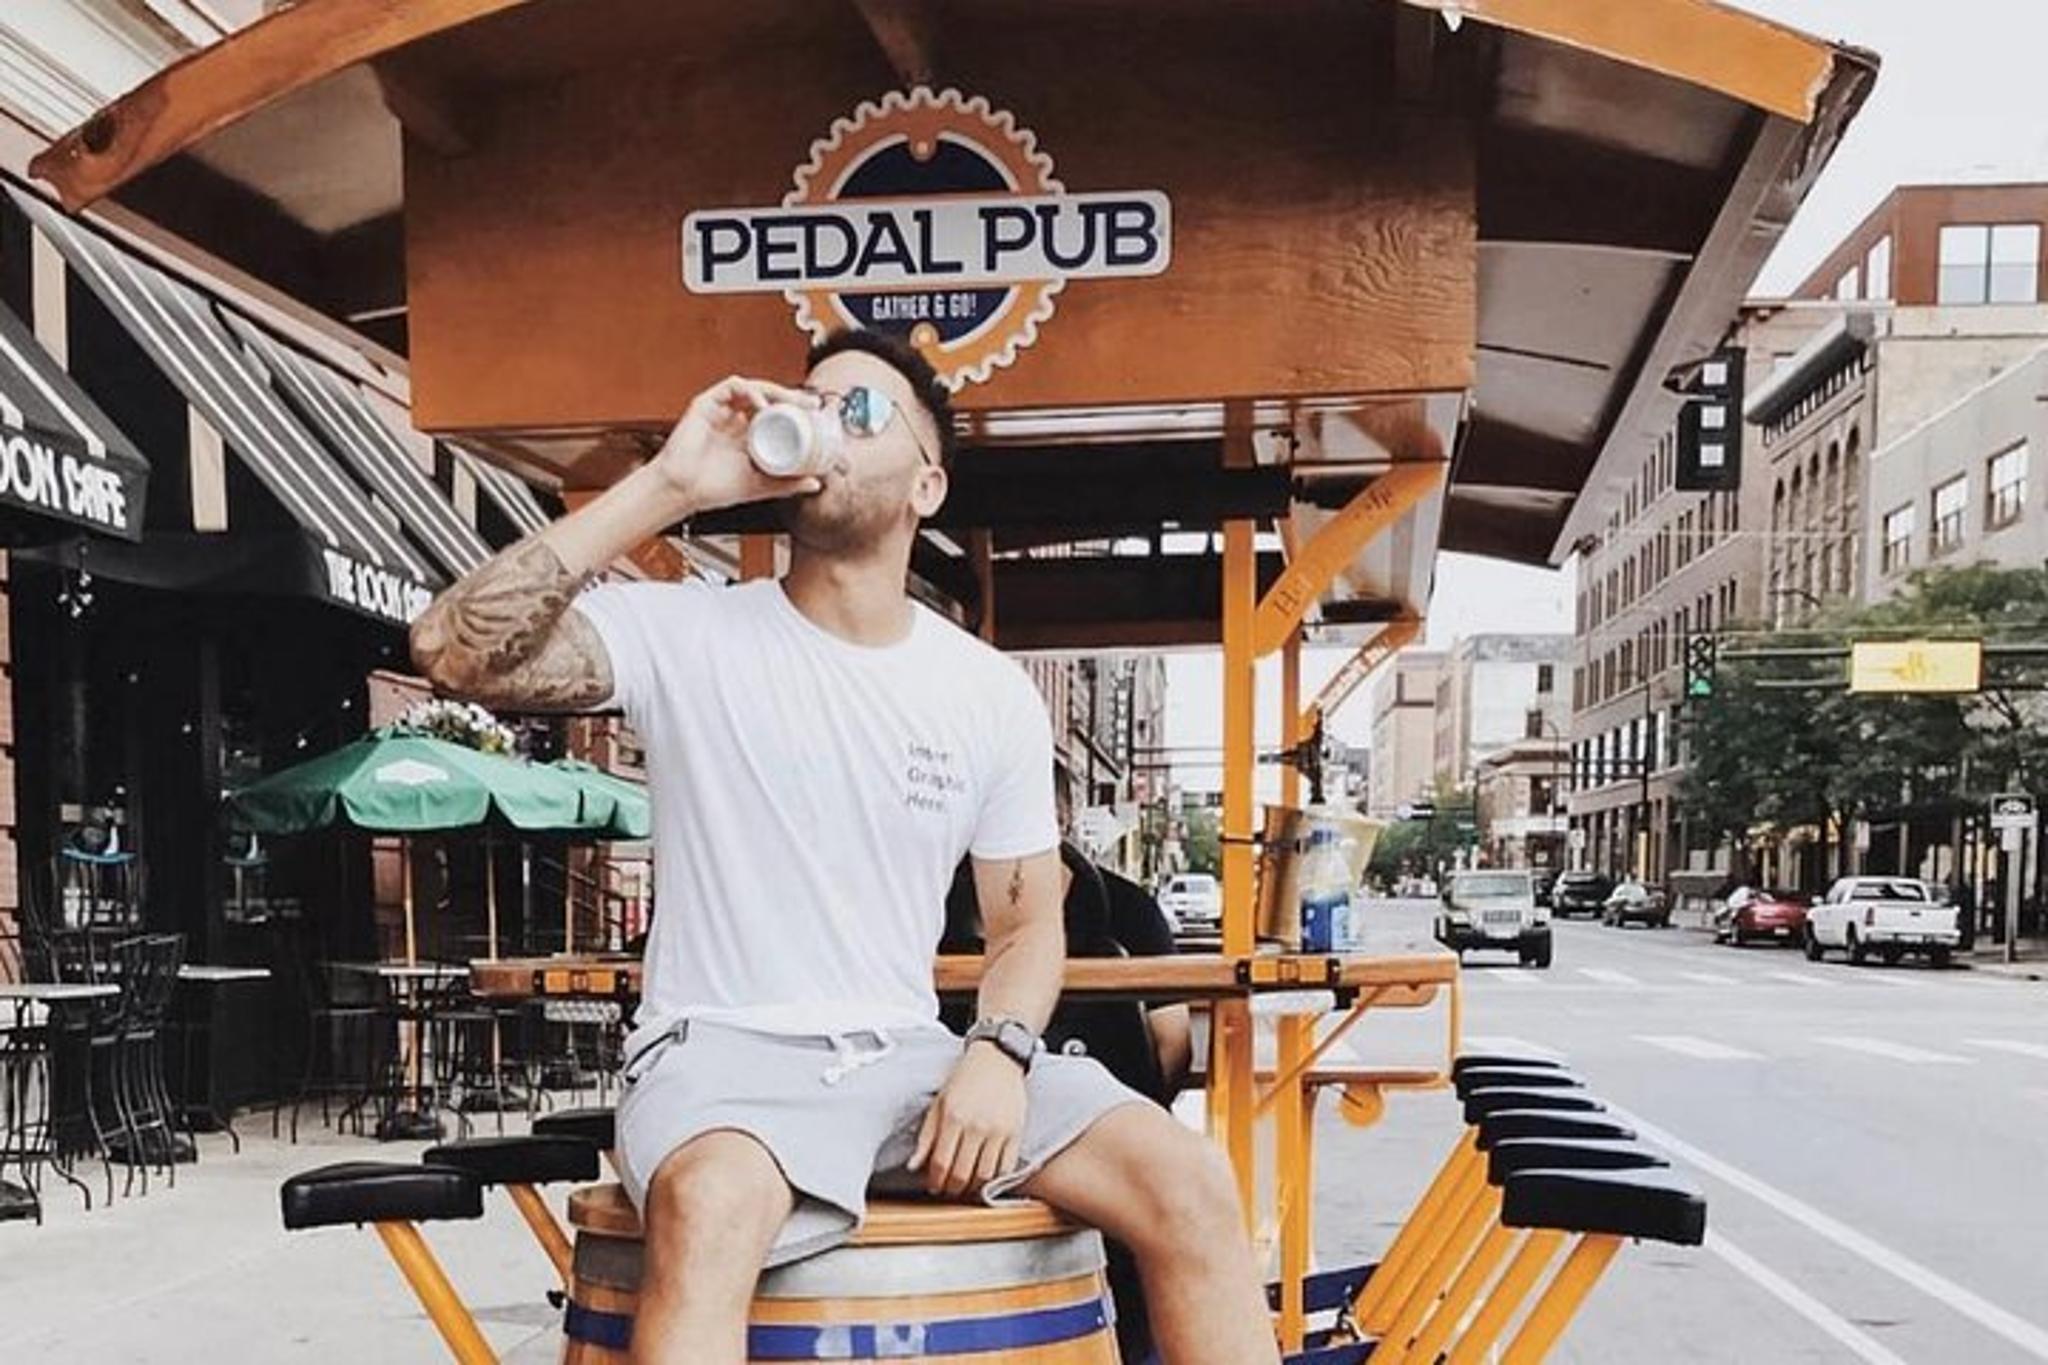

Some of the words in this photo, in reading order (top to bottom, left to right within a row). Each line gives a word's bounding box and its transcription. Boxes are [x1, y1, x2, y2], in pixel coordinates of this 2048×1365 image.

[695, 210, 963, 283] PEDAL
[978, 200, 1159, 272] PUB
[872, 295, 930, 320] GATHER
[949, 292, 976, 318] GO!
[62, 454, 126, 529] CAFE
[323, 548, 356, 604] THE
[355, 561, 402, 621] LOON
